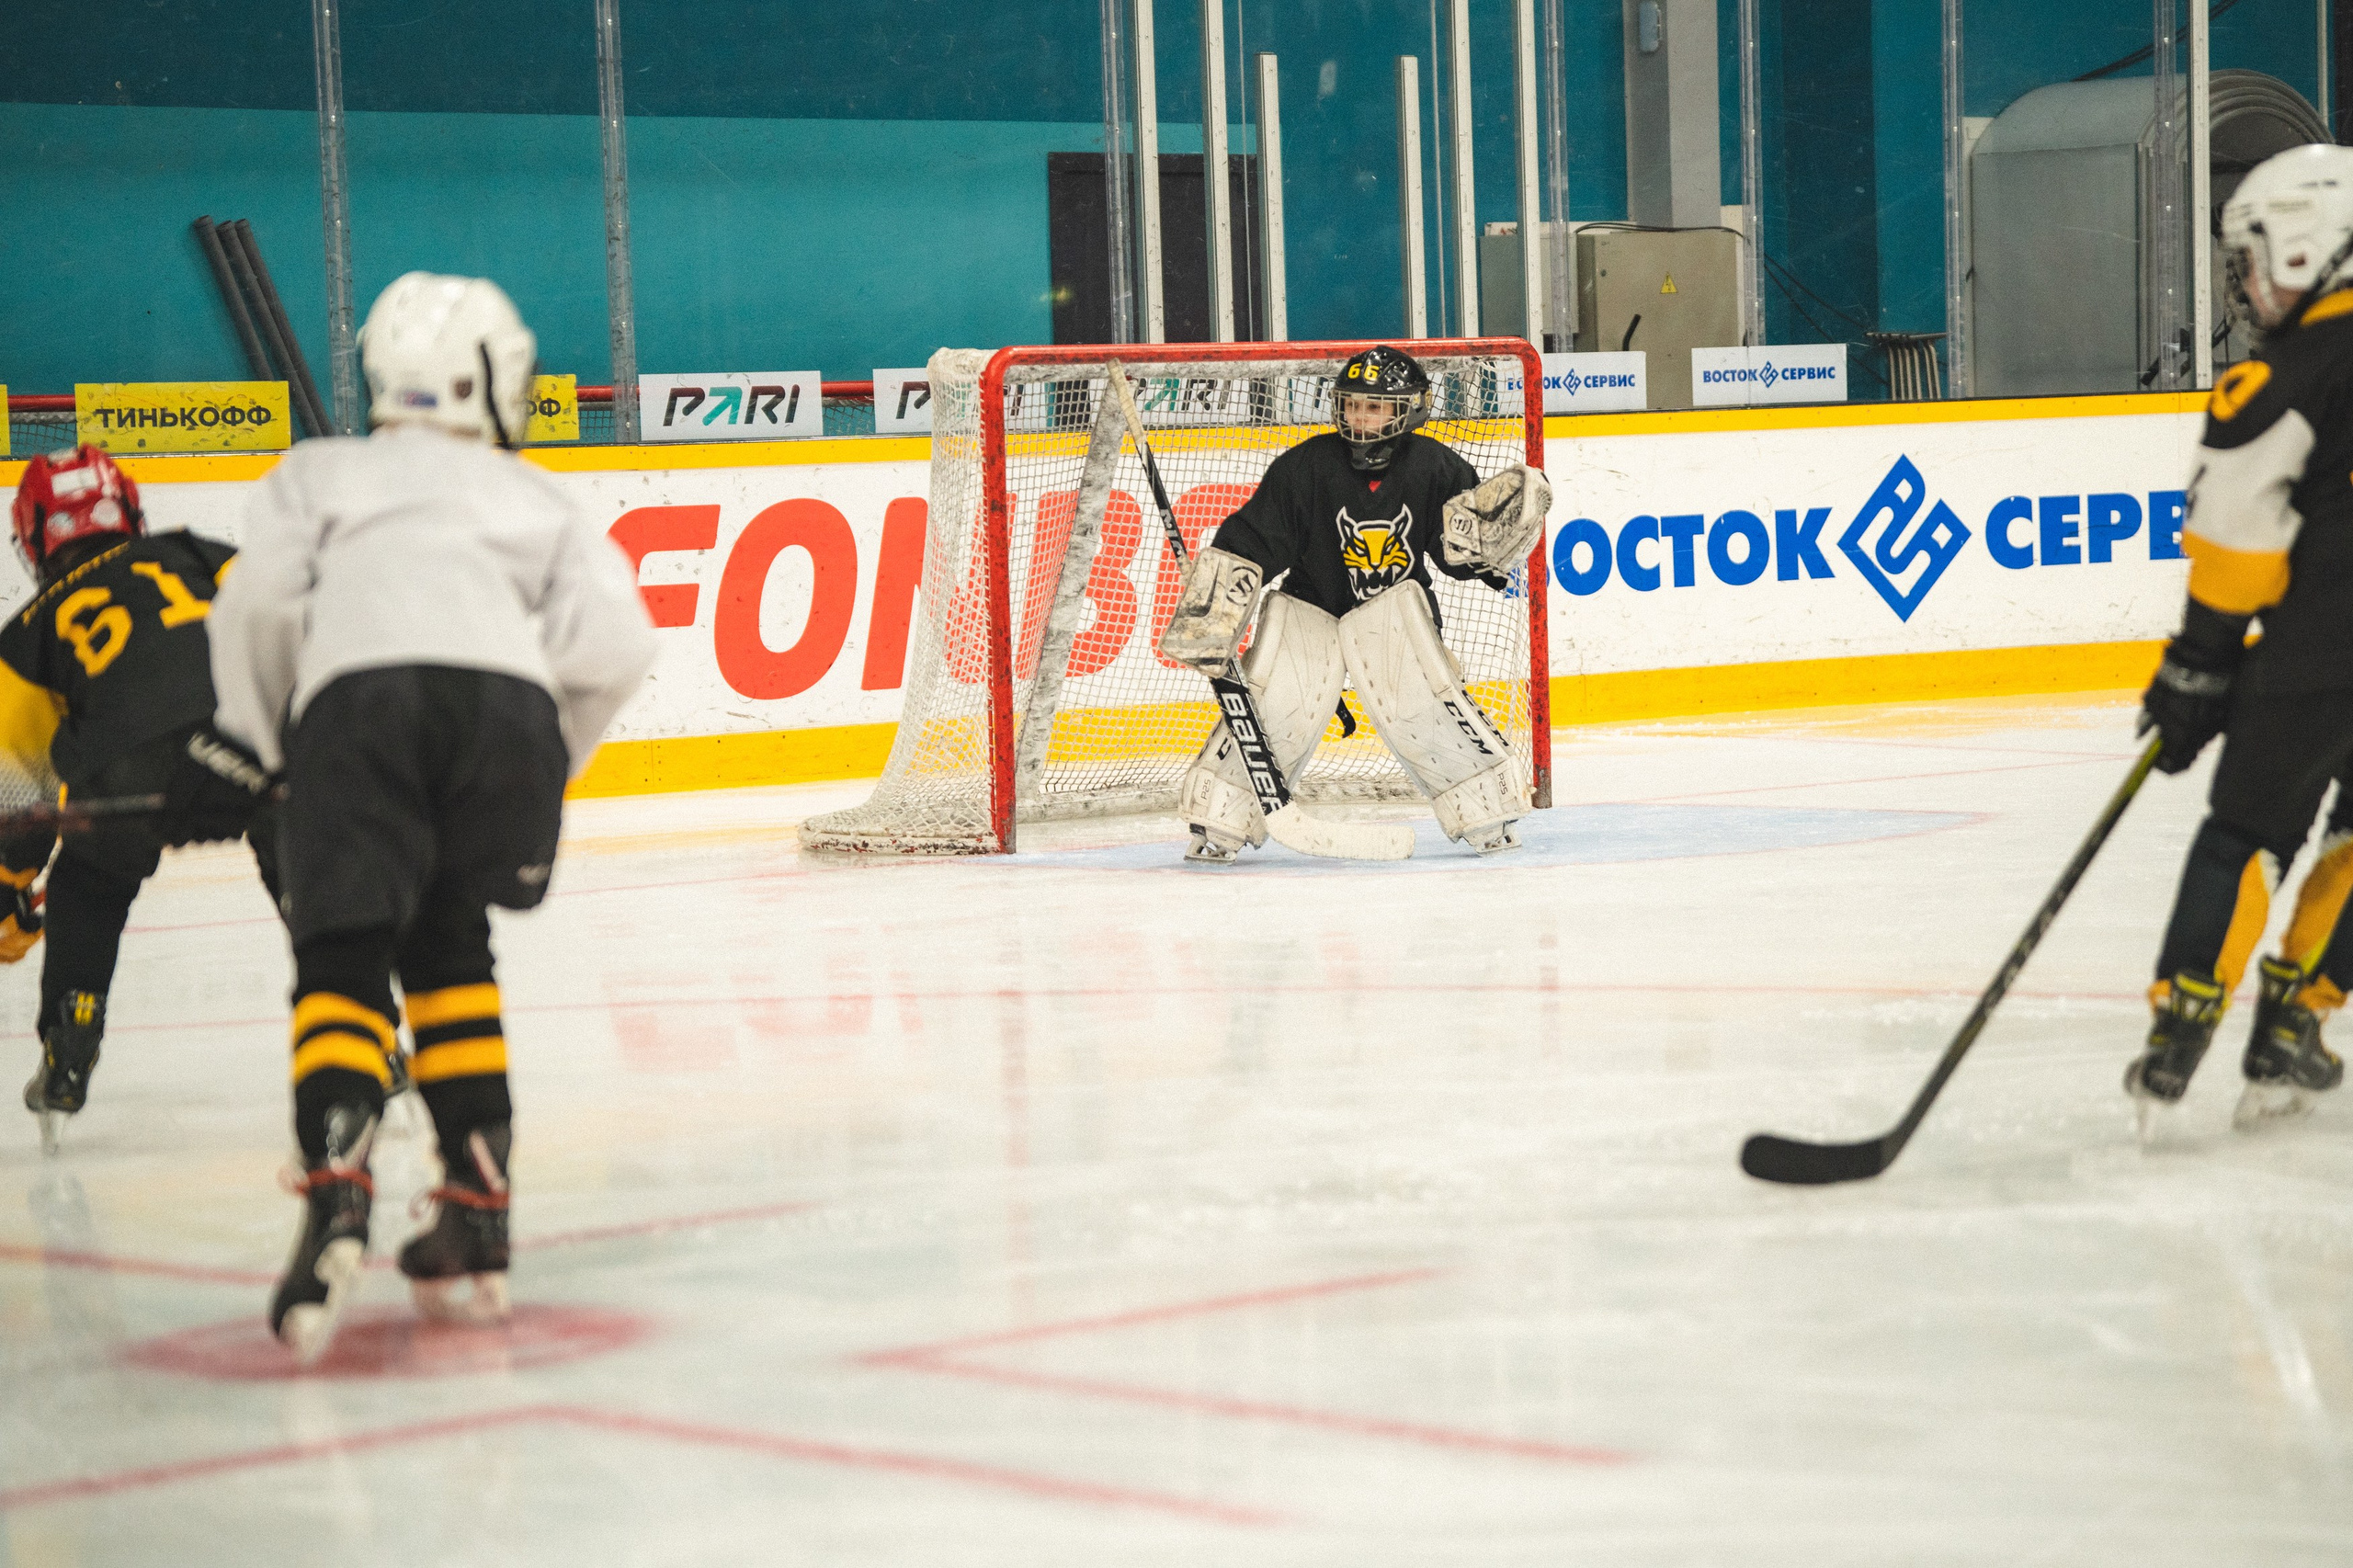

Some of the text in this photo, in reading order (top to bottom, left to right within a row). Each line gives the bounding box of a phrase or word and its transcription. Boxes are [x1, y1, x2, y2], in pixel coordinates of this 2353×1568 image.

[1347, 362, 1381, 381] 66
[1584, 374, 1635, 388] СЕРВИС
[1703, 367, 1836, 382] ВОСТОК СЕРВИС
[94, 405, 272, 428] ТИНЬКОФФ
[663, 384, 801, 426] PARI
[1985, 490, 2187, 570] СЕРВ
[55, 562, 212, 677] 61
[1443, 700, 1494, 755] CCM
